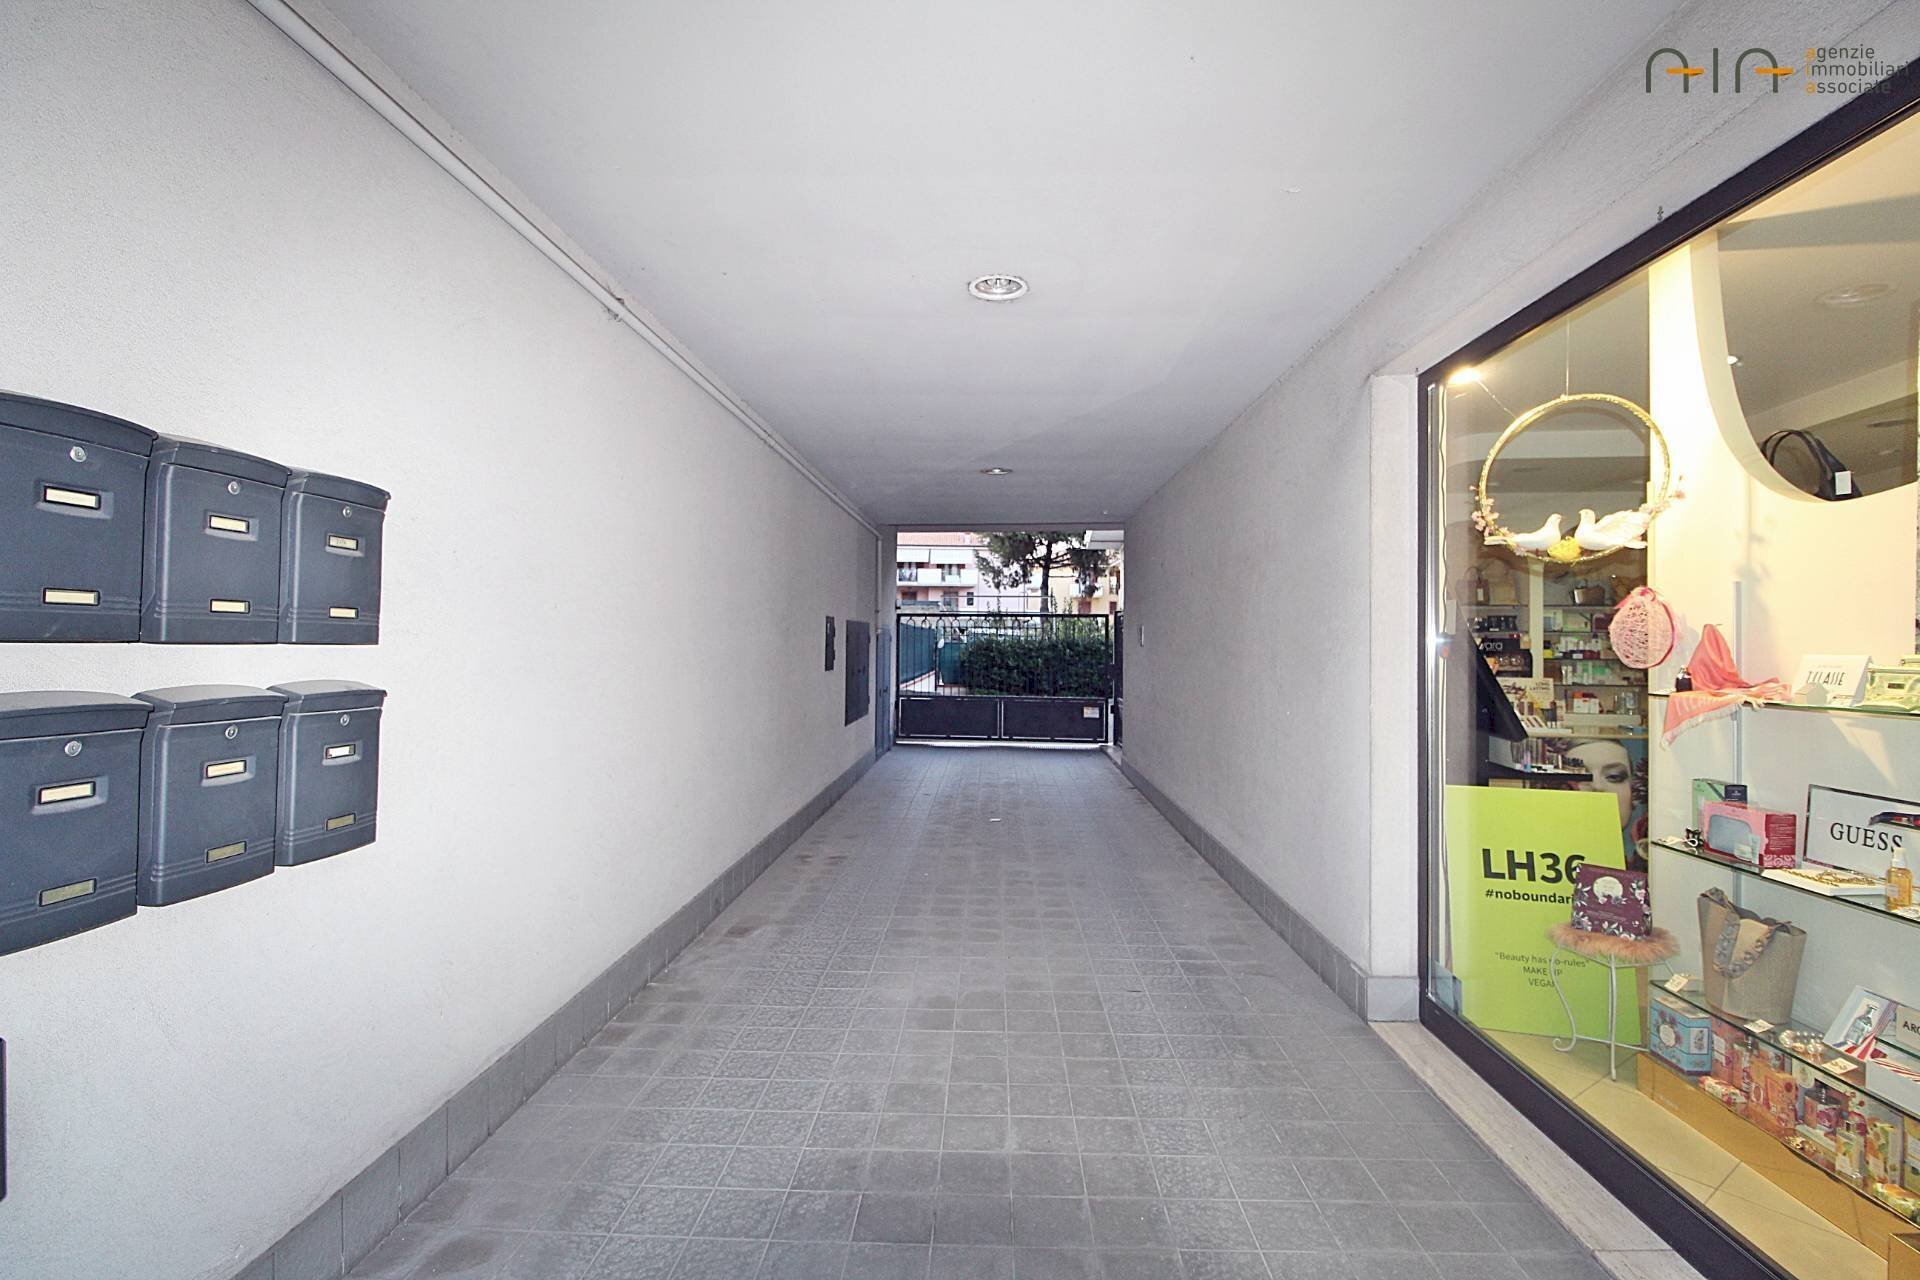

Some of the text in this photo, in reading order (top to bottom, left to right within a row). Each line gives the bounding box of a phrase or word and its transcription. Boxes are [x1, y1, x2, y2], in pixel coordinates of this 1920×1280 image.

[1830, 822, 1902, 852] GUESS
[1482, 848, 1585, 884] LH36
[1485, 889, 1574, 904] #noboundari
[1522, 966, 1548, 976] MAKE
